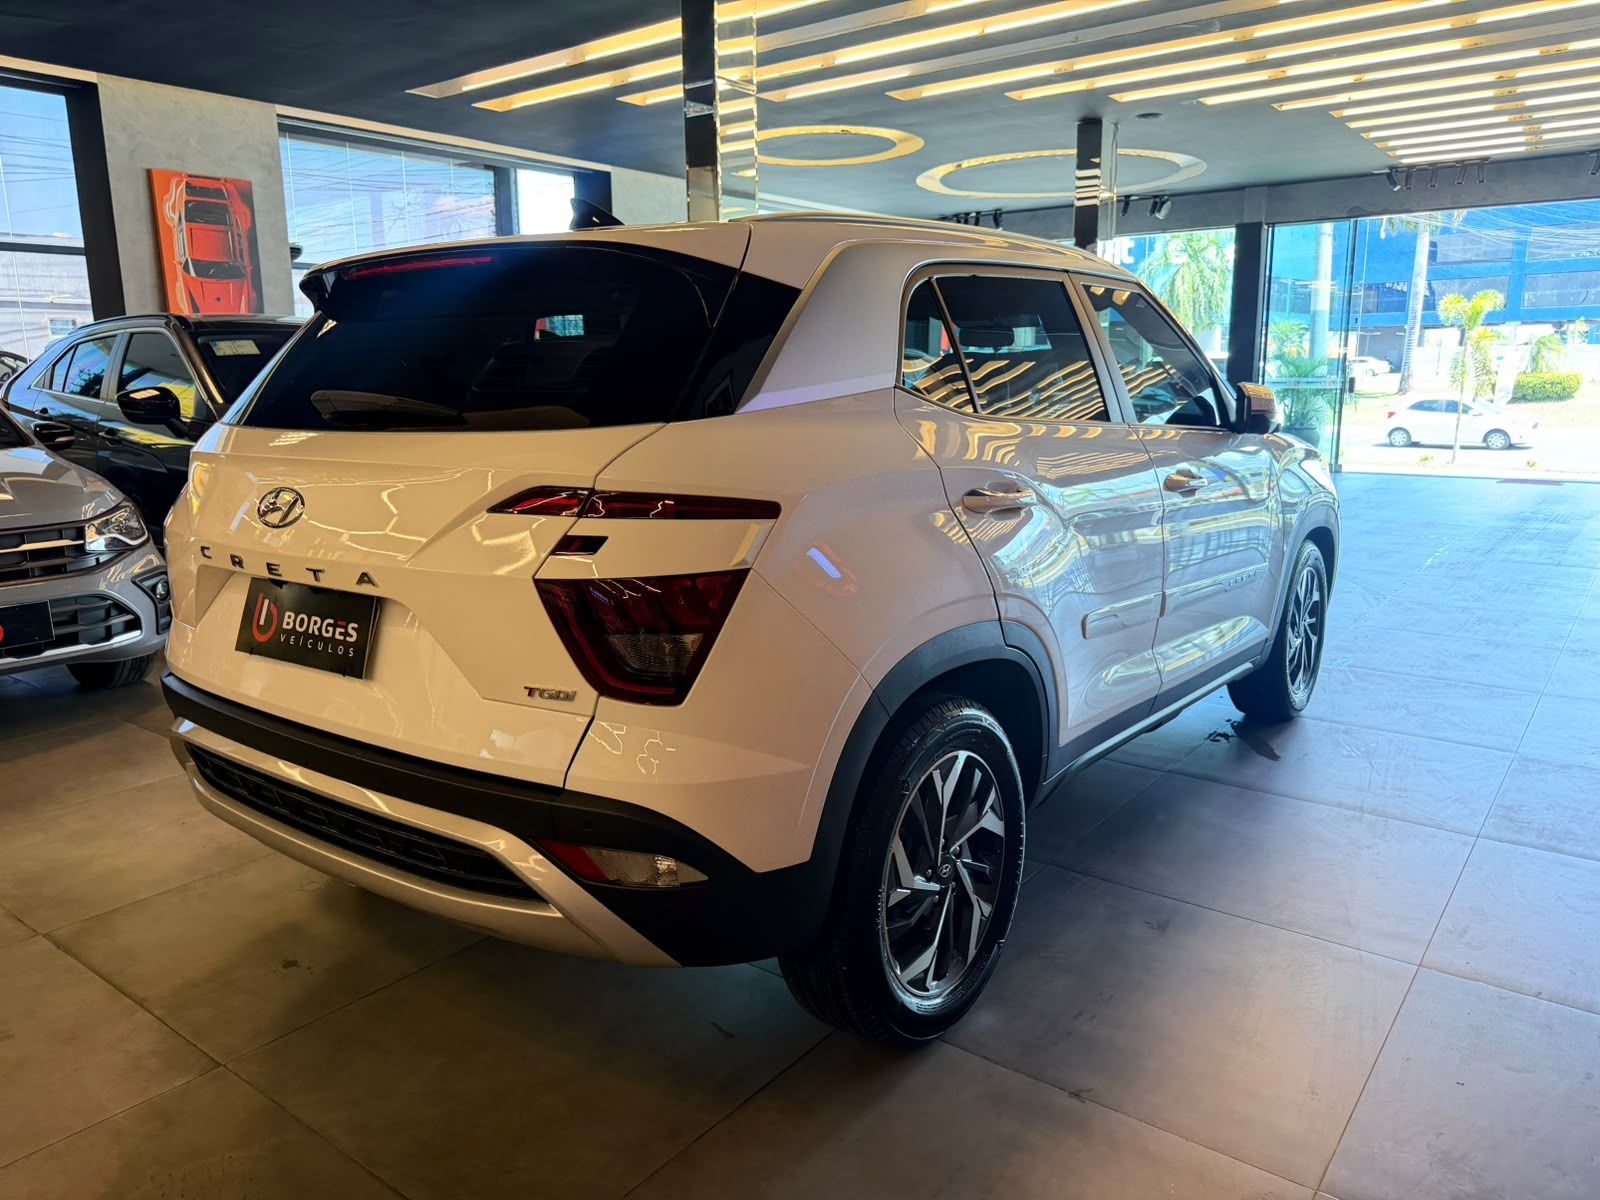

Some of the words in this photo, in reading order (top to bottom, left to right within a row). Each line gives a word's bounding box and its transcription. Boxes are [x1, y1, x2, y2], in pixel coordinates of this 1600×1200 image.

[200, 545, 379, 588] CRETA
[282, 611, 359, 642] BORGES
[280, 633, 355, 657] VEÍCULOS
